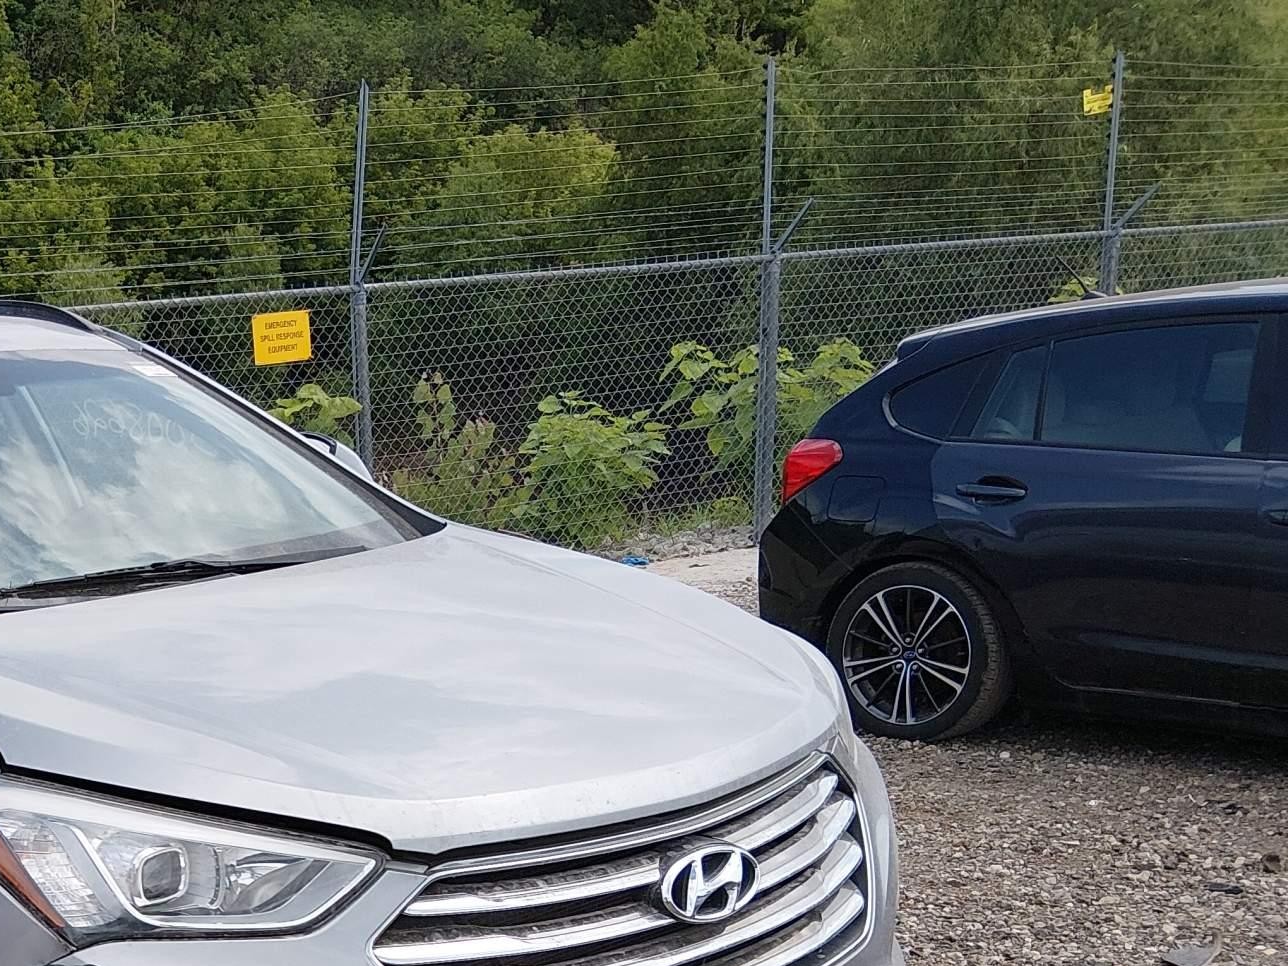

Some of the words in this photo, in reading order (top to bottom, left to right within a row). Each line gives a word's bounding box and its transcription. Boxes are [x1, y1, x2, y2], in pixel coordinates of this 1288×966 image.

[264, 320, 297, 330] EMERGENCY
[260, 333, 275, 342] SPILL
[276, 331, 304, 340] RESPONSE
[268, 344, 298, 354] EQUIPMENT
